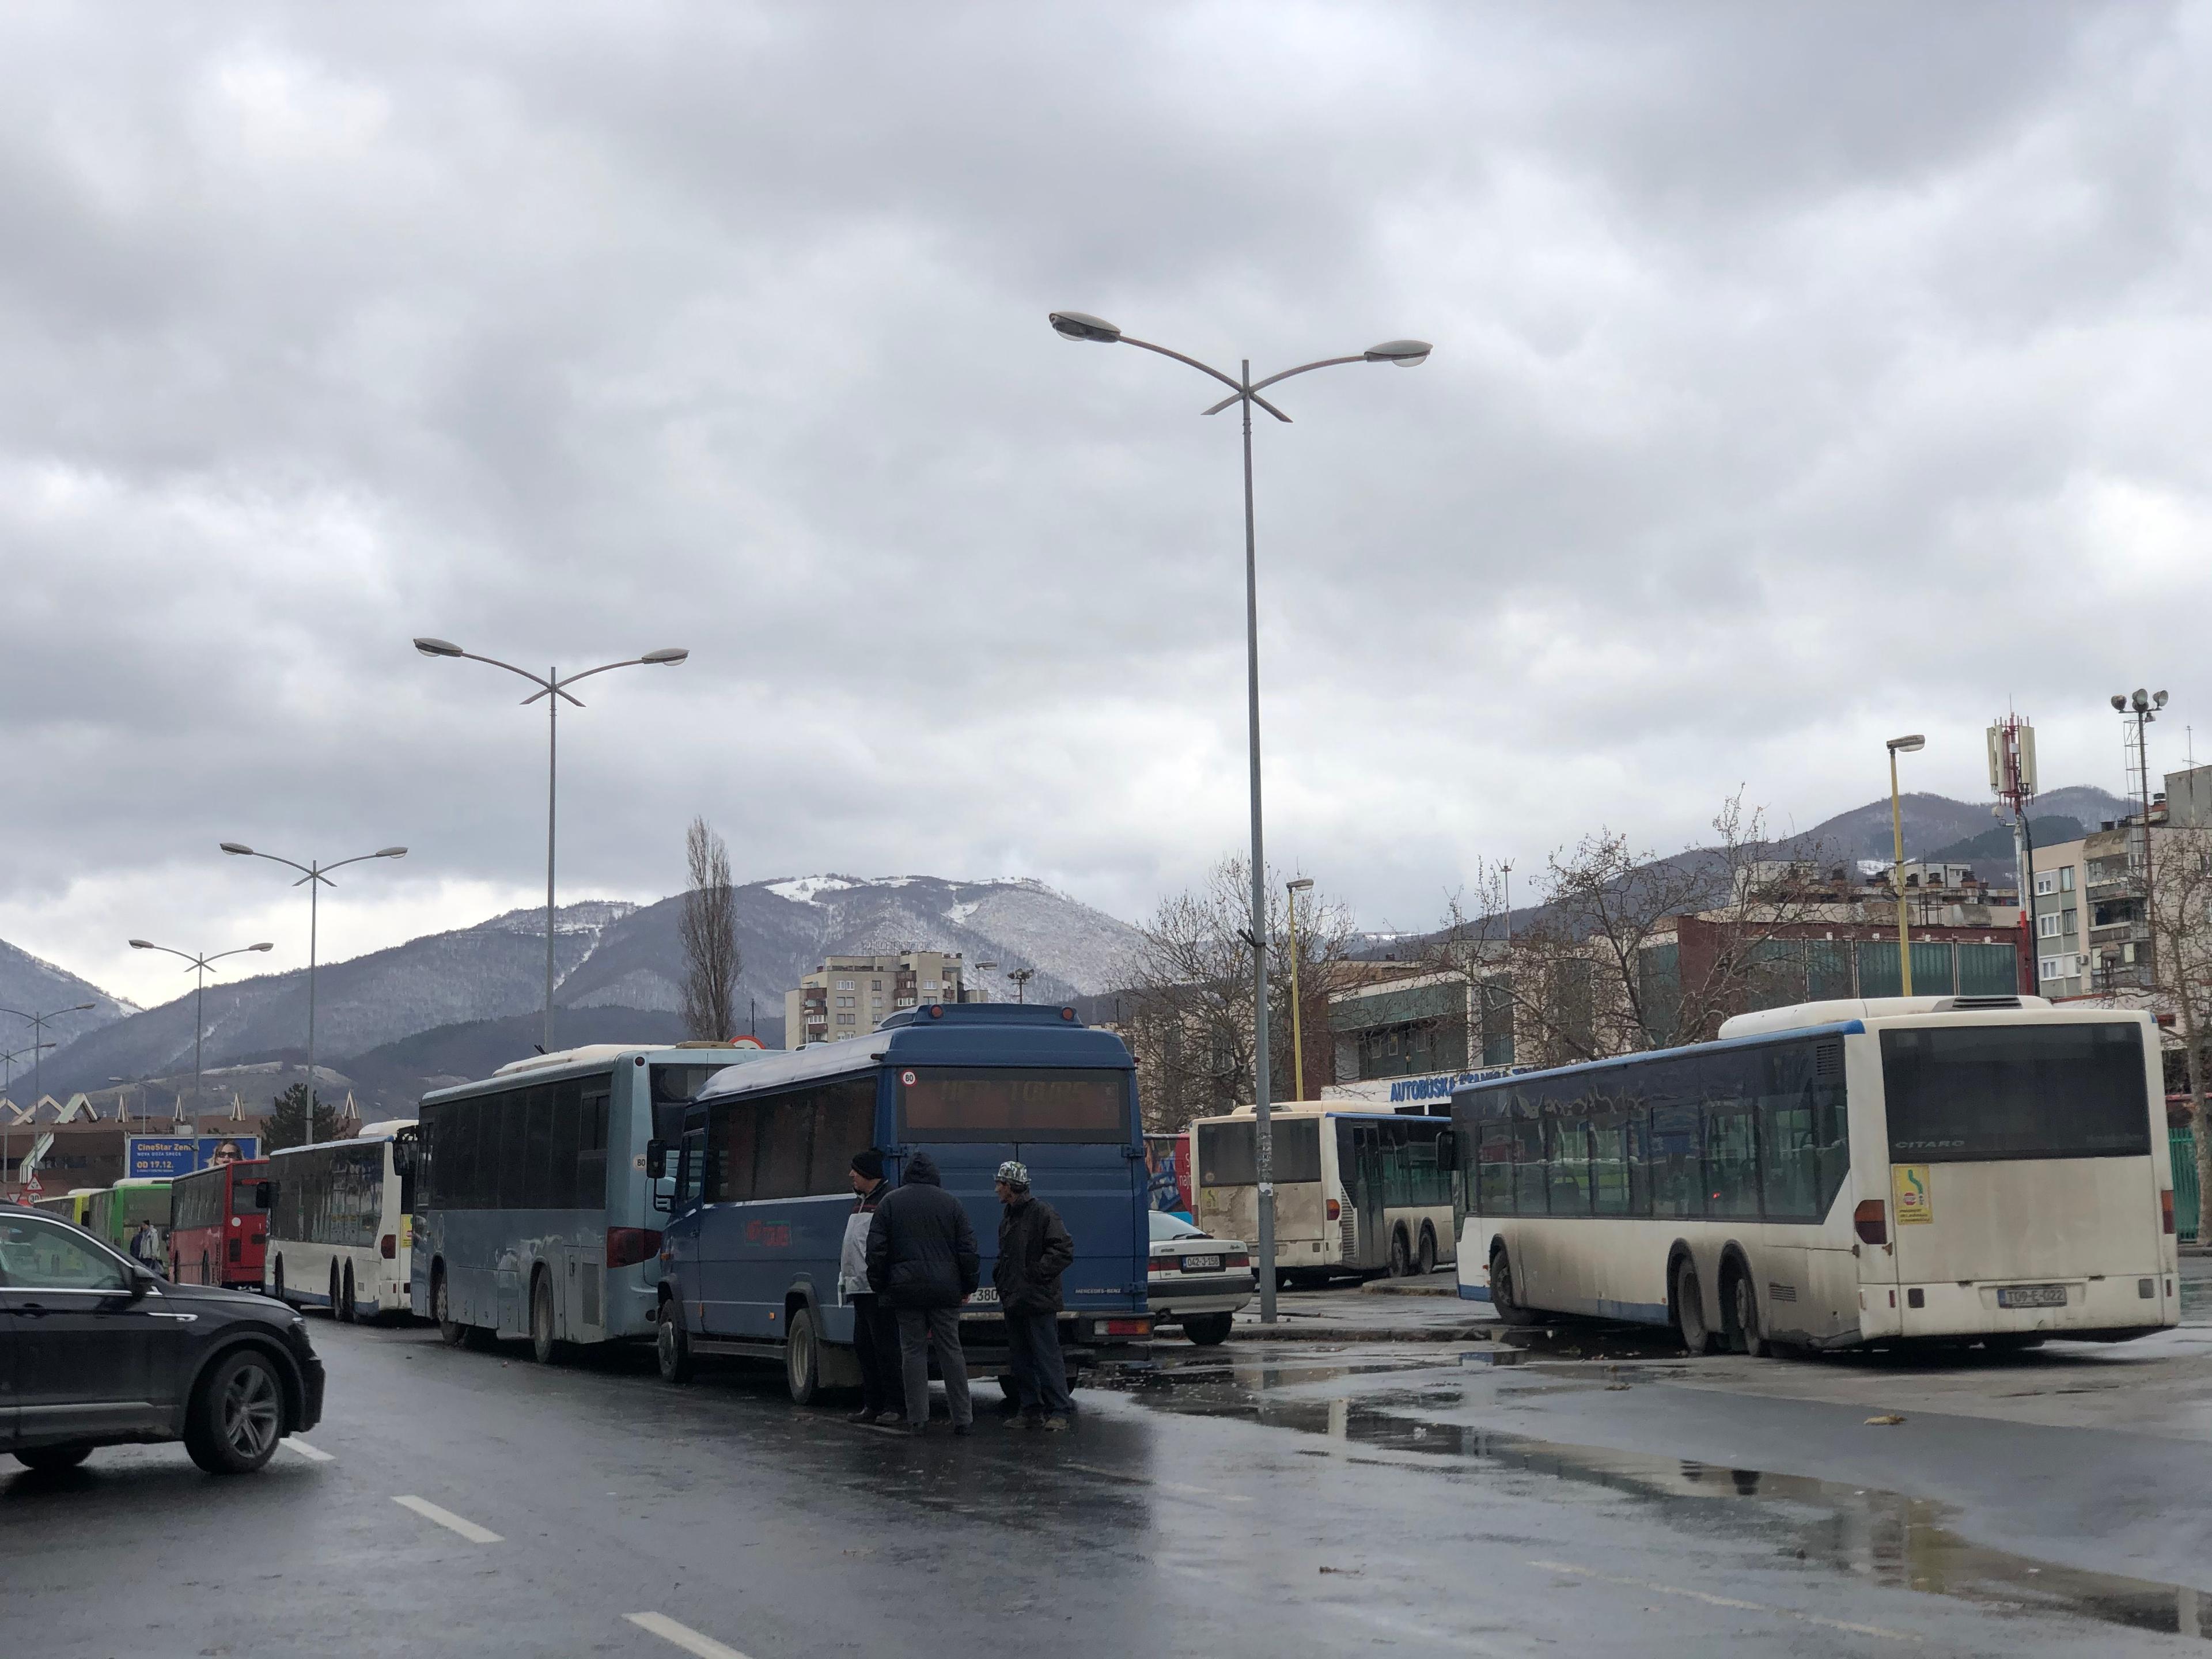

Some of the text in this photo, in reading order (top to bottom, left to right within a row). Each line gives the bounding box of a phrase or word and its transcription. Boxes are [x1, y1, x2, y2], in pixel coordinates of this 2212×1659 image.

[1391, 1076, 1456, 1102] AUTOBUSKA
[1895, 1140, 1965, 1148] CITARO
[637, 1158, 645, 1166] 80
[1185, 1153, 1190, 1168] S
[137, 1161, 148, 1169] OD
[30, 1195, 40, 1203] 30
[972, 1289, 998, 1301] -380
